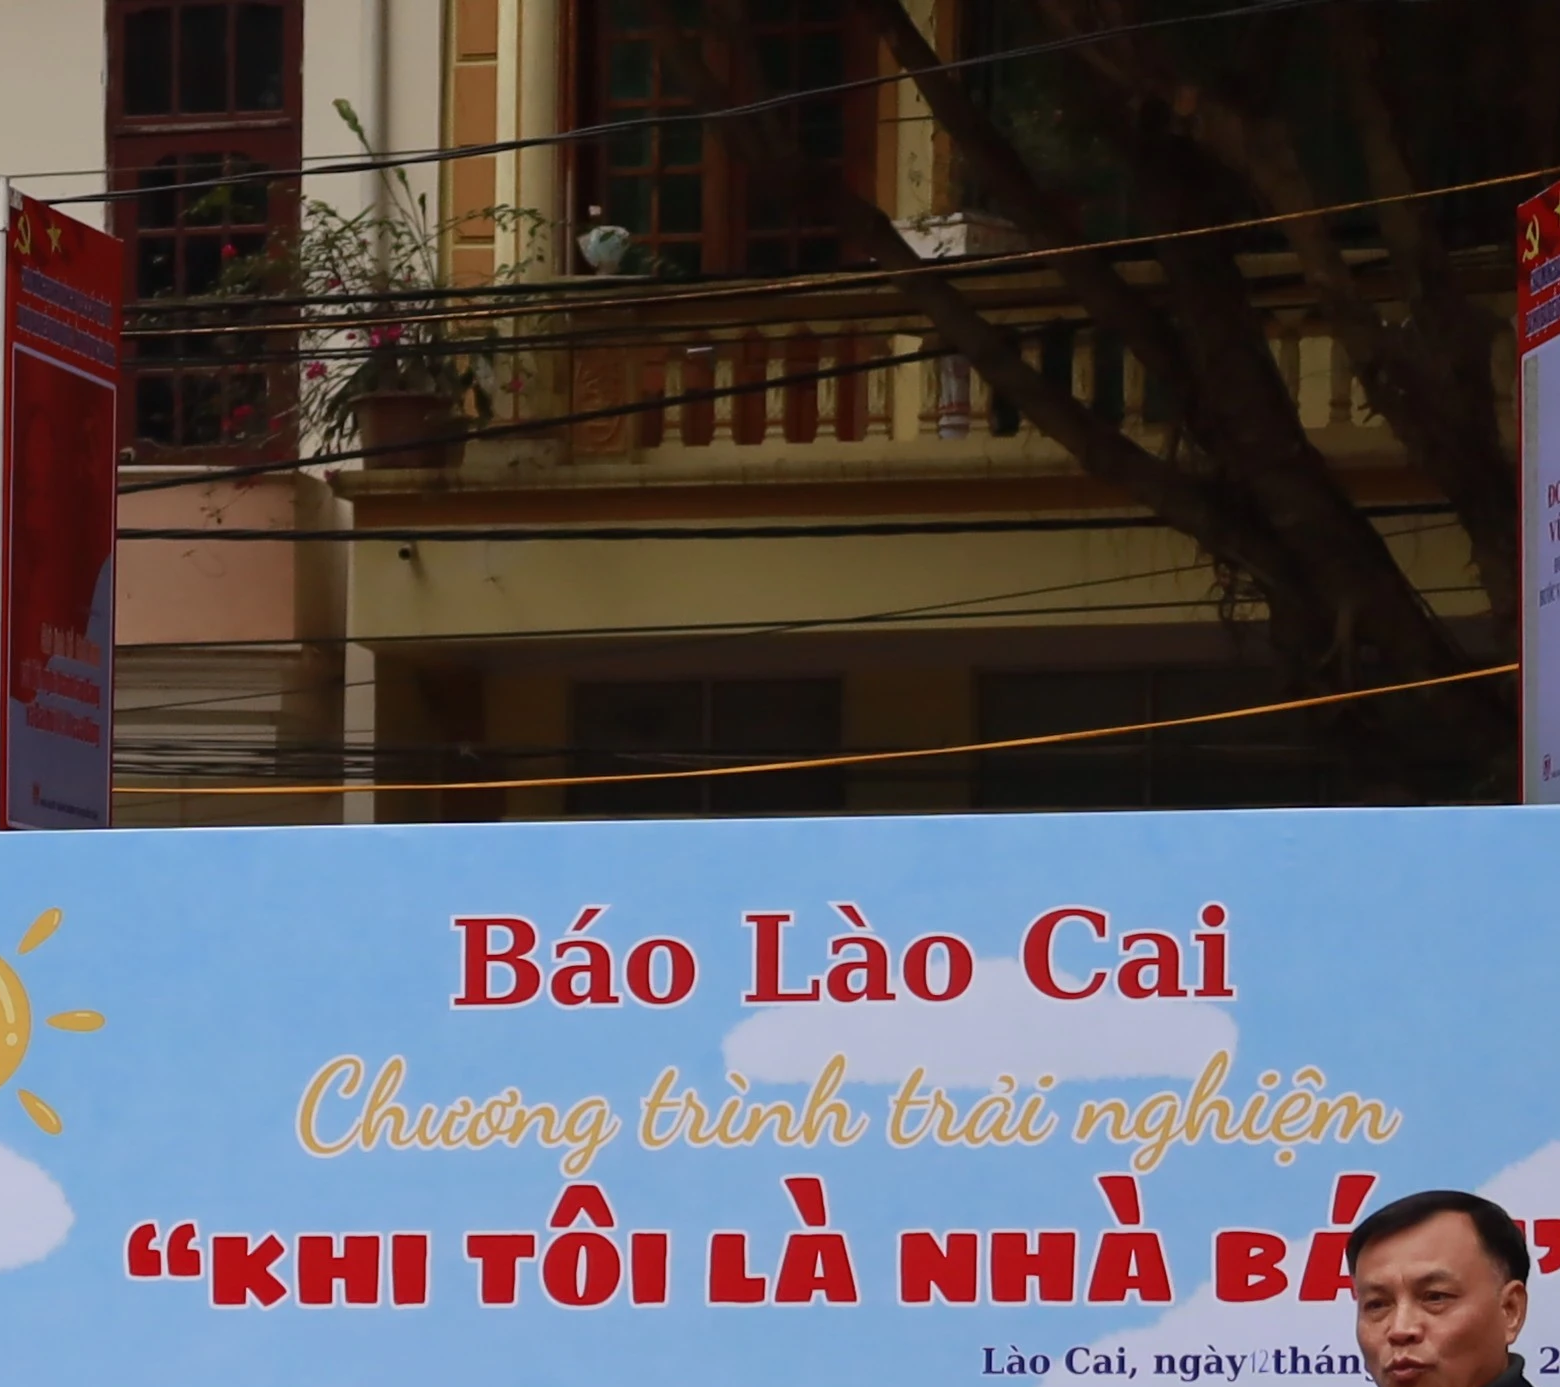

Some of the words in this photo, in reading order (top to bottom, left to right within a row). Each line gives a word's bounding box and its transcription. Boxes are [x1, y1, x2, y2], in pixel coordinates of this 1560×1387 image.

[453, 908, 695, 1006] Báo
[745, 904, 973, 1003] Lào
[1023, 904, 1234, 1001] Cai
[298, 1056, 616, 1174] Chương
[638, 1056, 860, 1146] trình
[888, 1068, 1054, 1145] trải
[1076, 1053, 1400, 1171] nghiệm
[127, 1222, 427, 1306] “KHI
[466, 1183, 668, 1306] TÔI
[708, 1176, 858, 1304] LÀ
[900, 1174, 1172, 1303] NHÀ
[982, 1345, 1051, 1376] Lào
[1064, 1347, 1138, 1379] Cai,
[1153, 1345, 1247, 1382] ngày
[1273, 1346, 1375, 1382] thán
